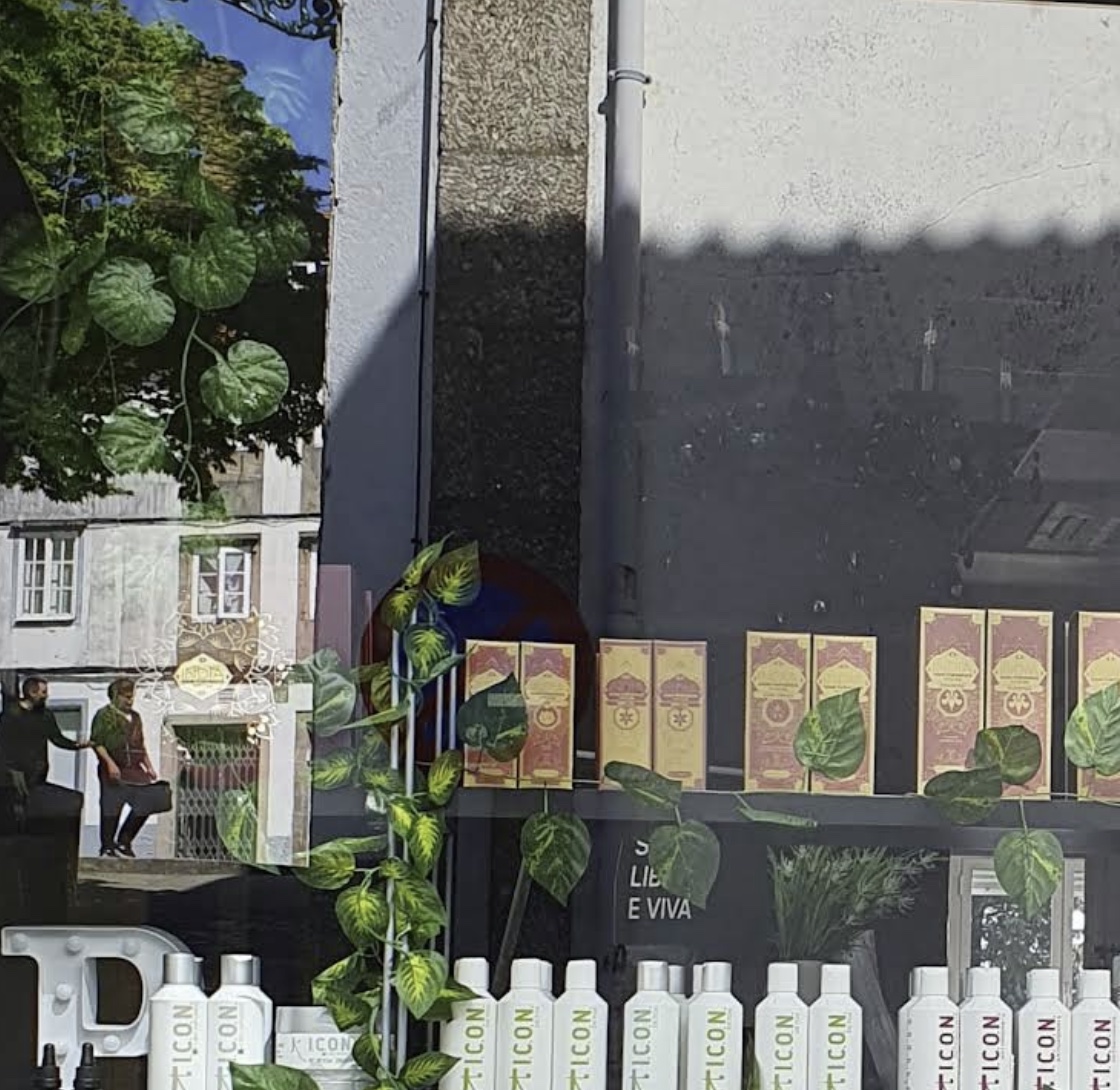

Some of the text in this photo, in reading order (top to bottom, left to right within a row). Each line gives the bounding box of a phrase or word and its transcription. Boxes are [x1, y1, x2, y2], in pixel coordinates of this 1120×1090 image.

[630, 865, 661, 887] LIB
[628, 897, 691, 919] E VIVA
